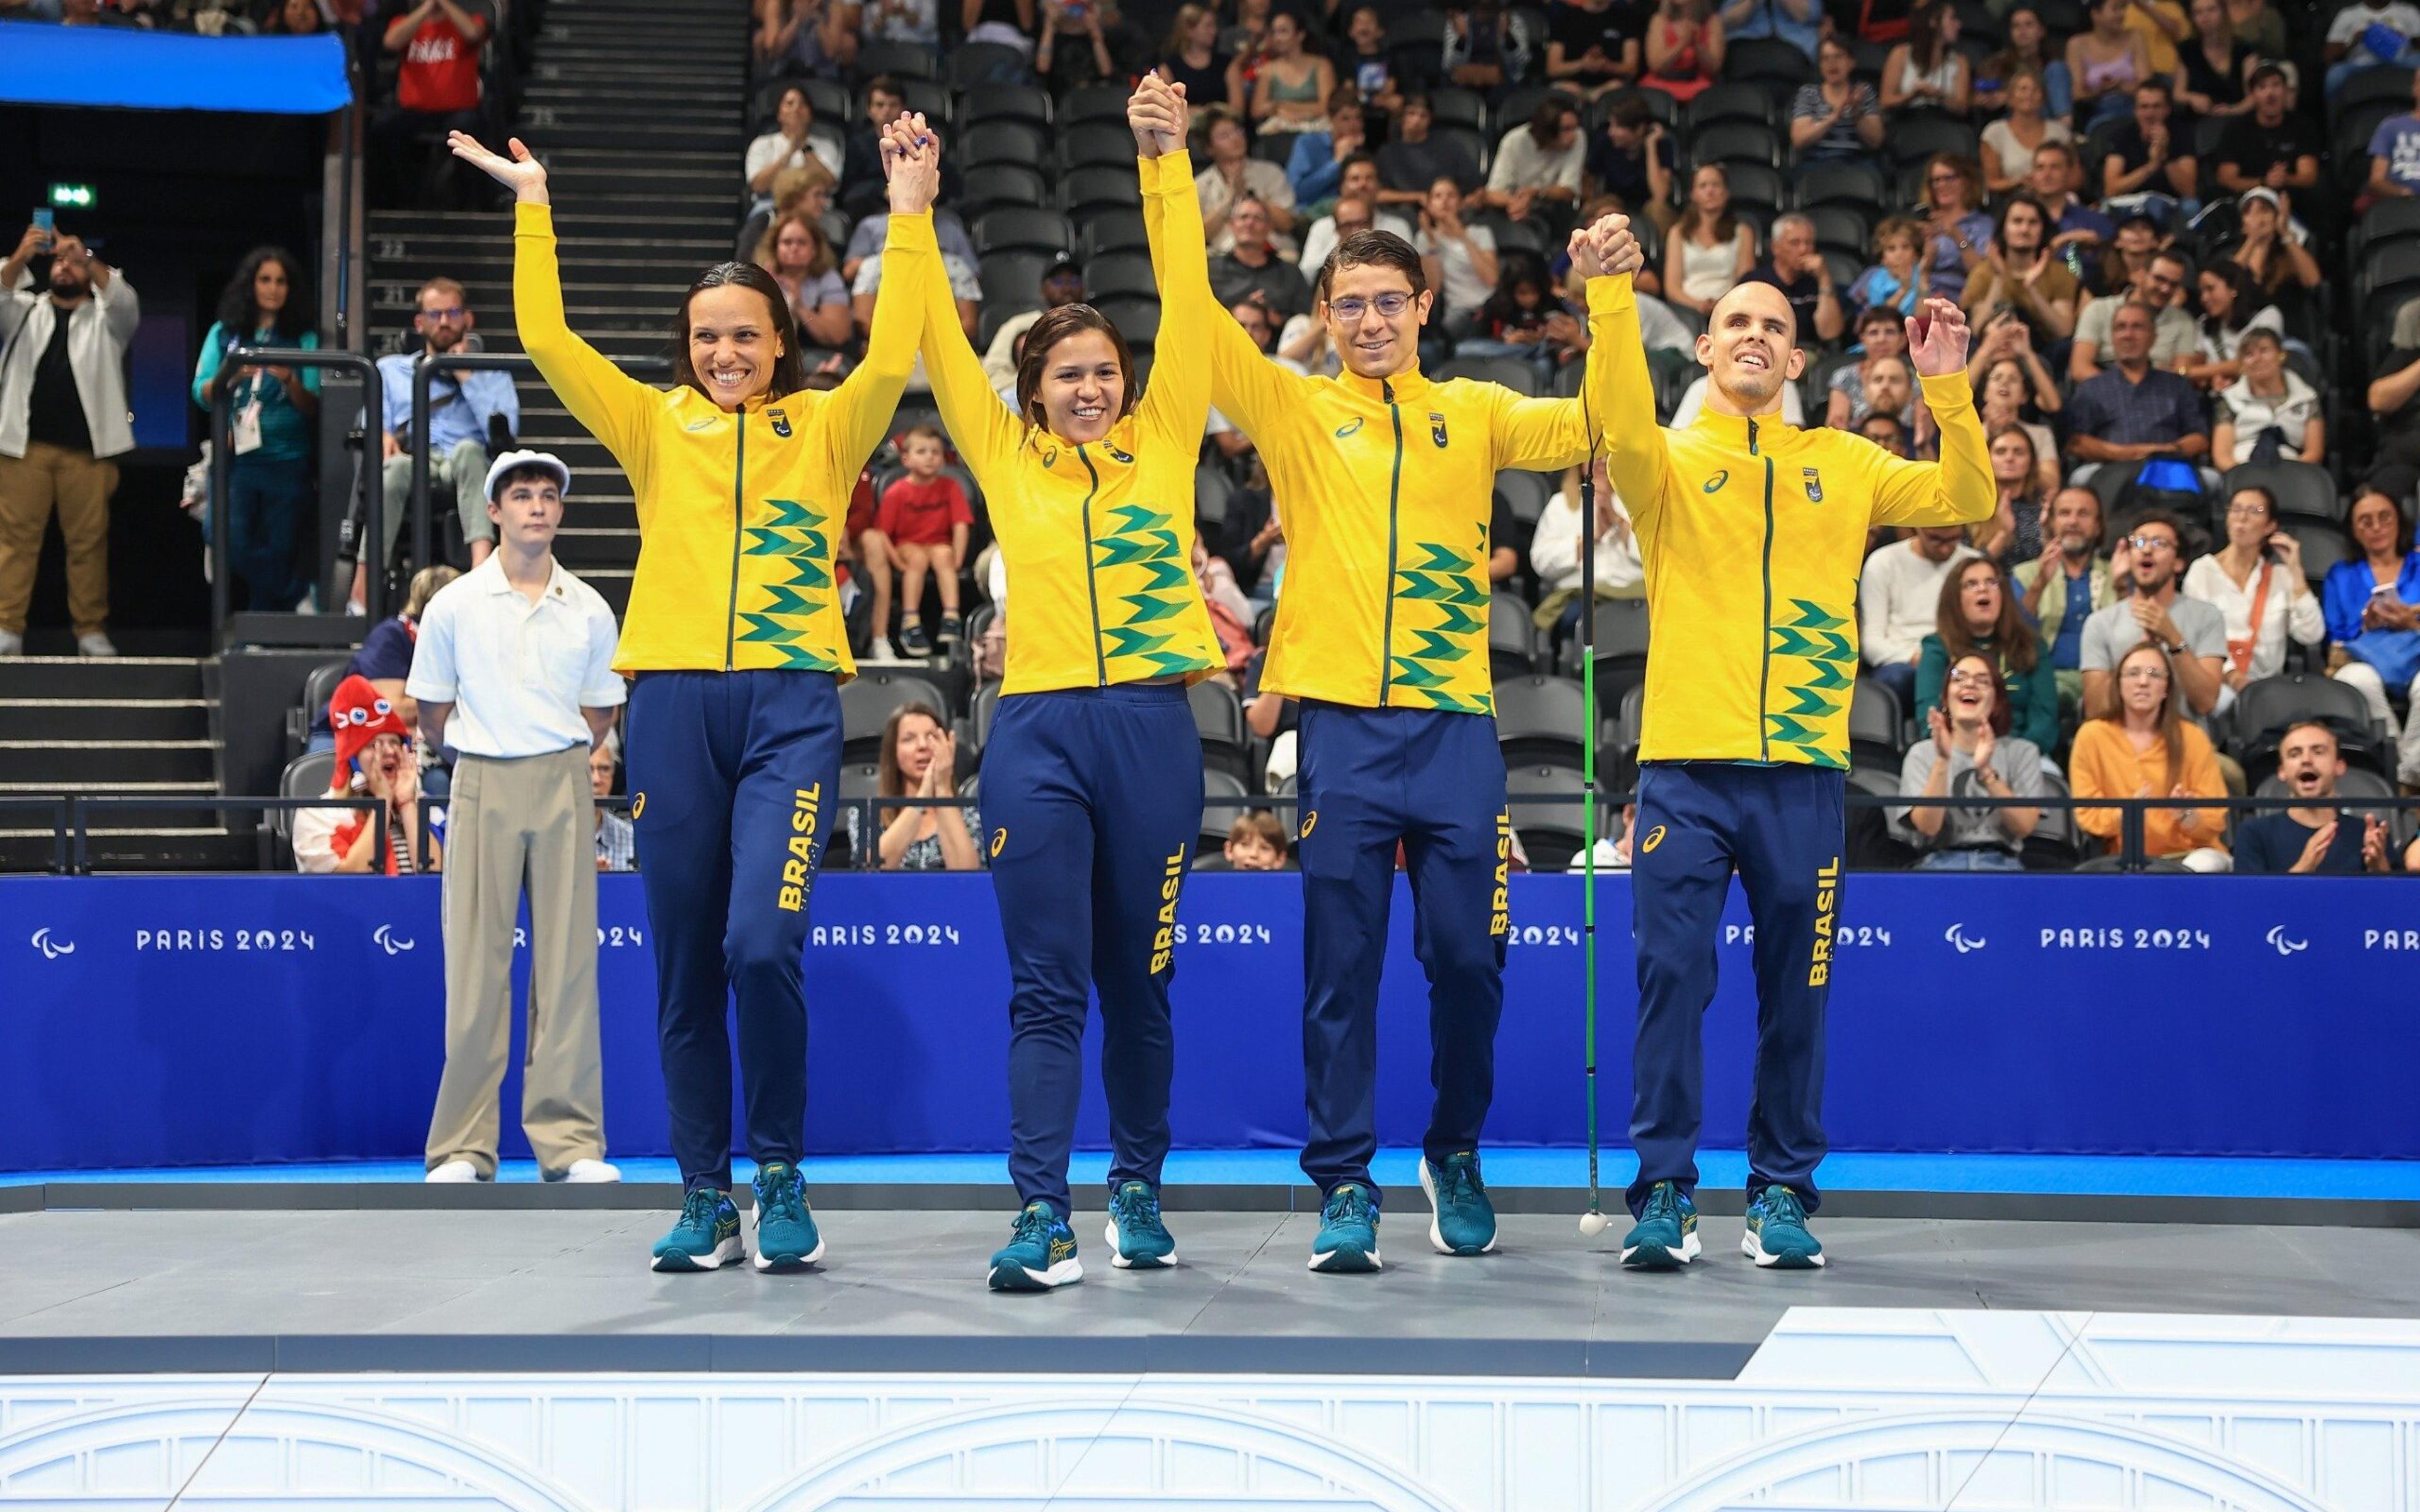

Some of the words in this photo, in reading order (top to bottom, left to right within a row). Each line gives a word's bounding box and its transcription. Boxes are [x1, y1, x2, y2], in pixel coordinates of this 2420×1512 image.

[778, 782, 821, 912] BRASIL
[1490, 804, 1511, 936] BRASIL
[1150, 842, 1185, 975] BRASIL
[1809, 857, 1839, 987] BRASIL
[137, 929, 224, 951] PARIS
[236, 930, 314, 950] 2024
[596, 926, 642, 947] 24
[812, 925, 876, 946] ARIS
[885, 924, 959, 946] 2024
[1197, 924, 1270, 944] 2024
[1507, 925, 1579, 946] 2024
[1836, 926, 1891, 947] 024
[2041, 928, 2124, 949] PARIS
[2134, 929, 2210, 949] 2024
[2365, 929, 2420, 950] PAR
